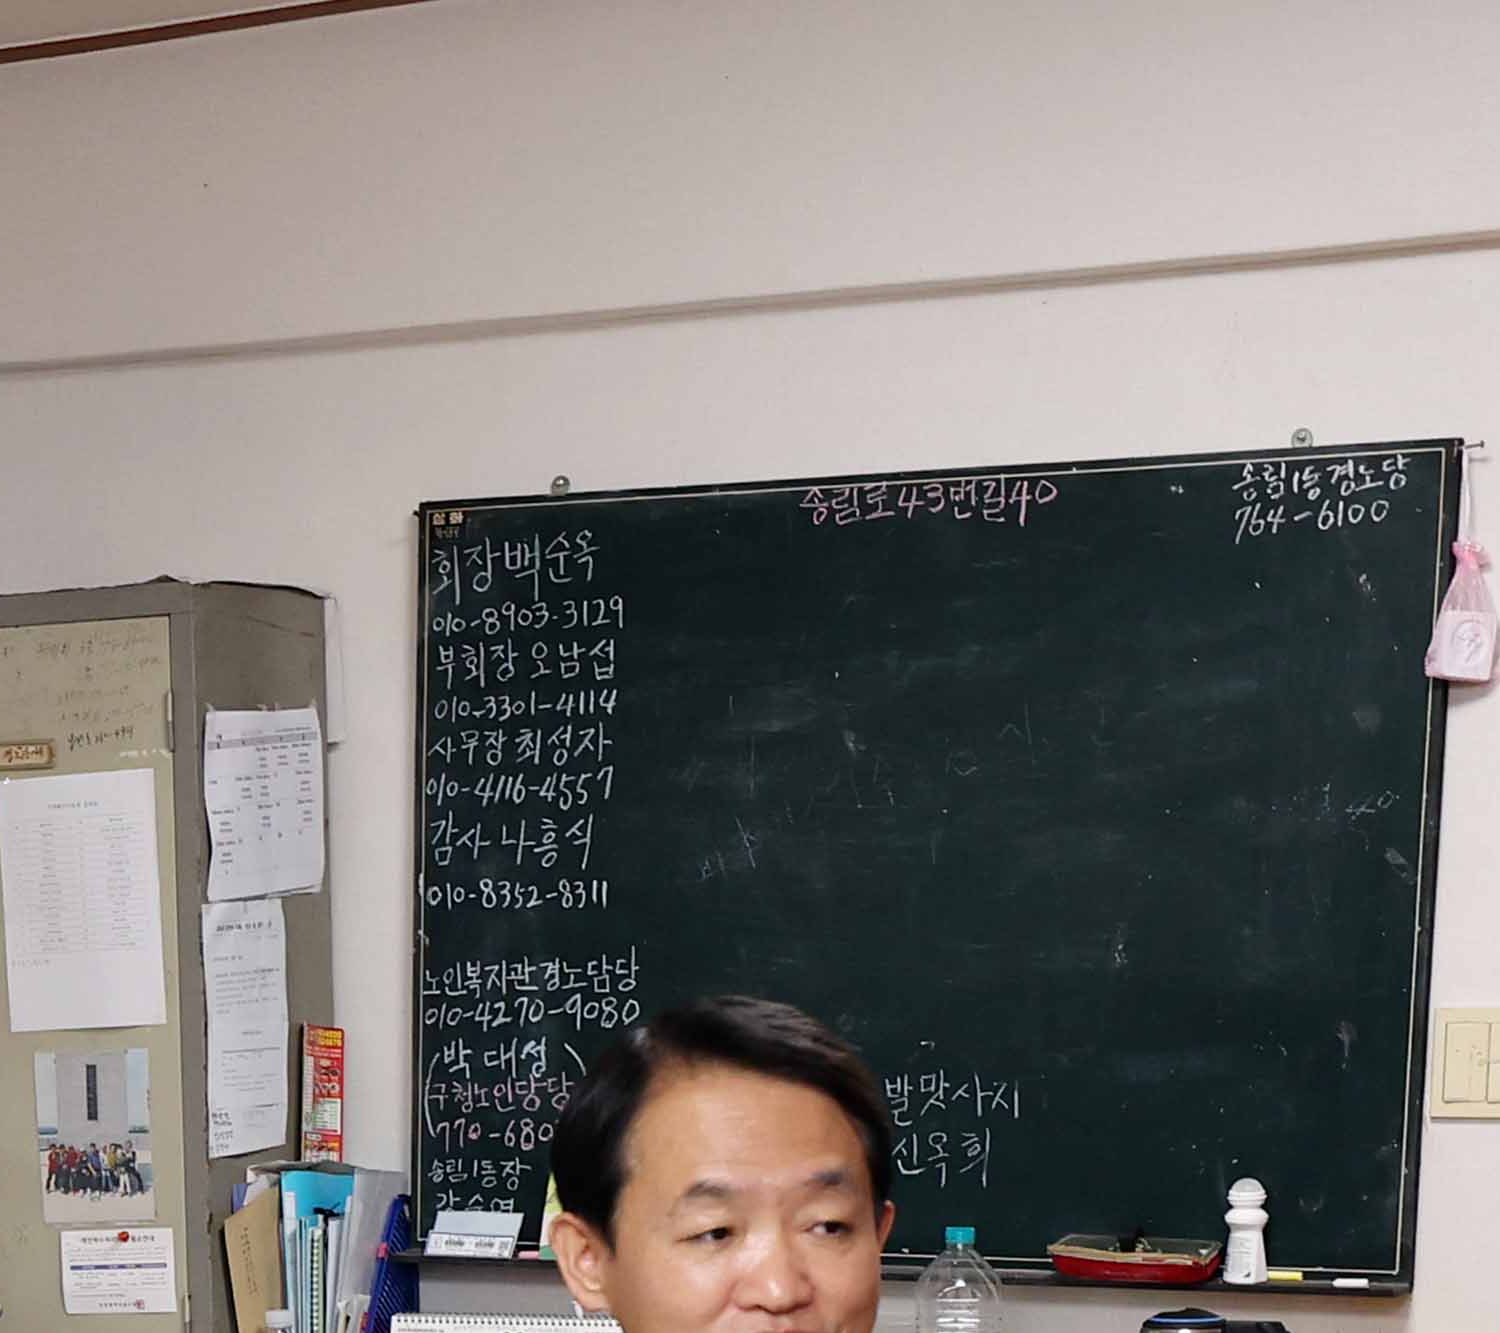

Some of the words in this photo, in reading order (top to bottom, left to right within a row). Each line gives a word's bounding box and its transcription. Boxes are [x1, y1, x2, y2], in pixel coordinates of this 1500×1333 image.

[1234, 498, 1390, 545] 764-6100
[432, 595, 624, 637] 010-8903-3129
[435, 638, 519, 690] 부회장
[530, 638, 616, 681] 오남섭
[434, 688, 618, 724] 010-3301-4114
[425, 764, 614, 811] 010-4116-4557
[429, 810, 491, 866] 감사
[425, 877, 609, 910] 010-8352-8311
[423, 993, 641, 1032] 010-4270-9080
